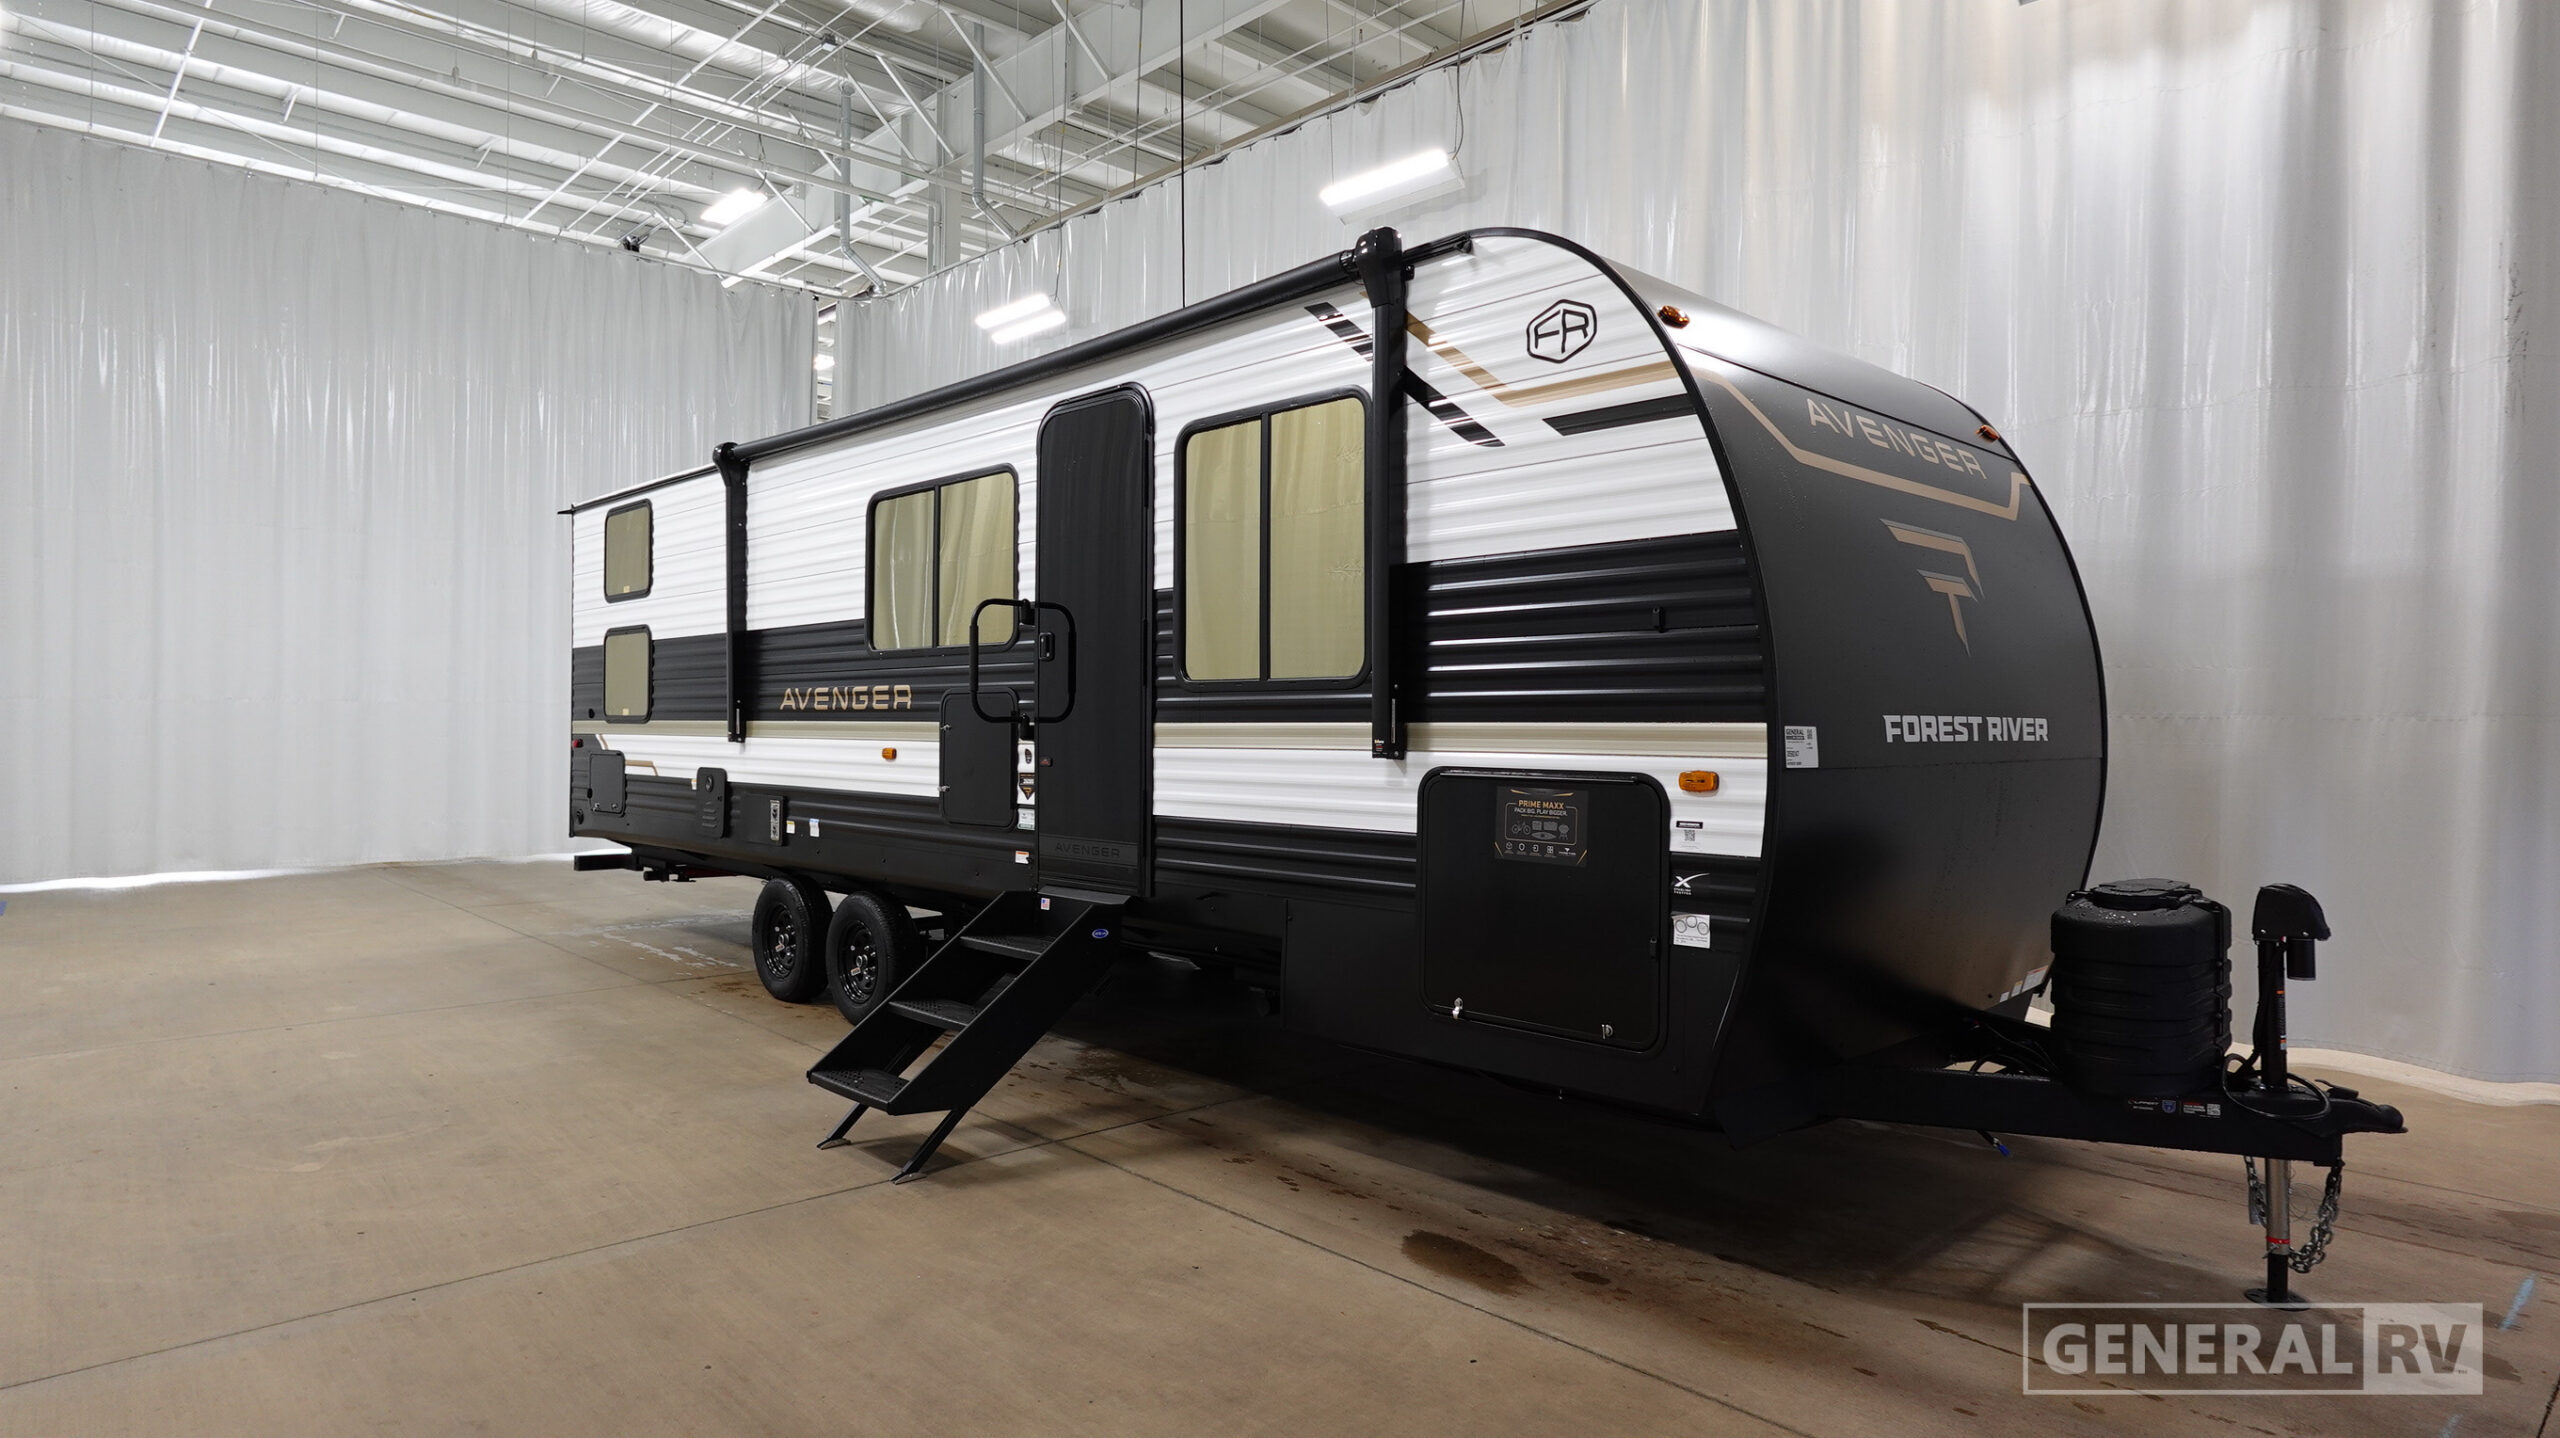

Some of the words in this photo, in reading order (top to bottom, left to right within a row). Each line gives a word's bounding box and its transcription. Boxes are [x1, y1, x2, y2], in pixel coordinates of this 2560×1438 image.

[1533, 308, 1589, 354] FR
[1807, 398, 1987, 480] AVENGER
[779, 684, 912, 711] AVENGER
[1882, 714, 1983, 743] FOREST
[1986, 716, 2049, 742] RIVER
[1518, 799, 1541, 809] PRIME
[1542, 801, 1565, 810] MAXX
[1055, 842, 1121, 858] AVENGER
